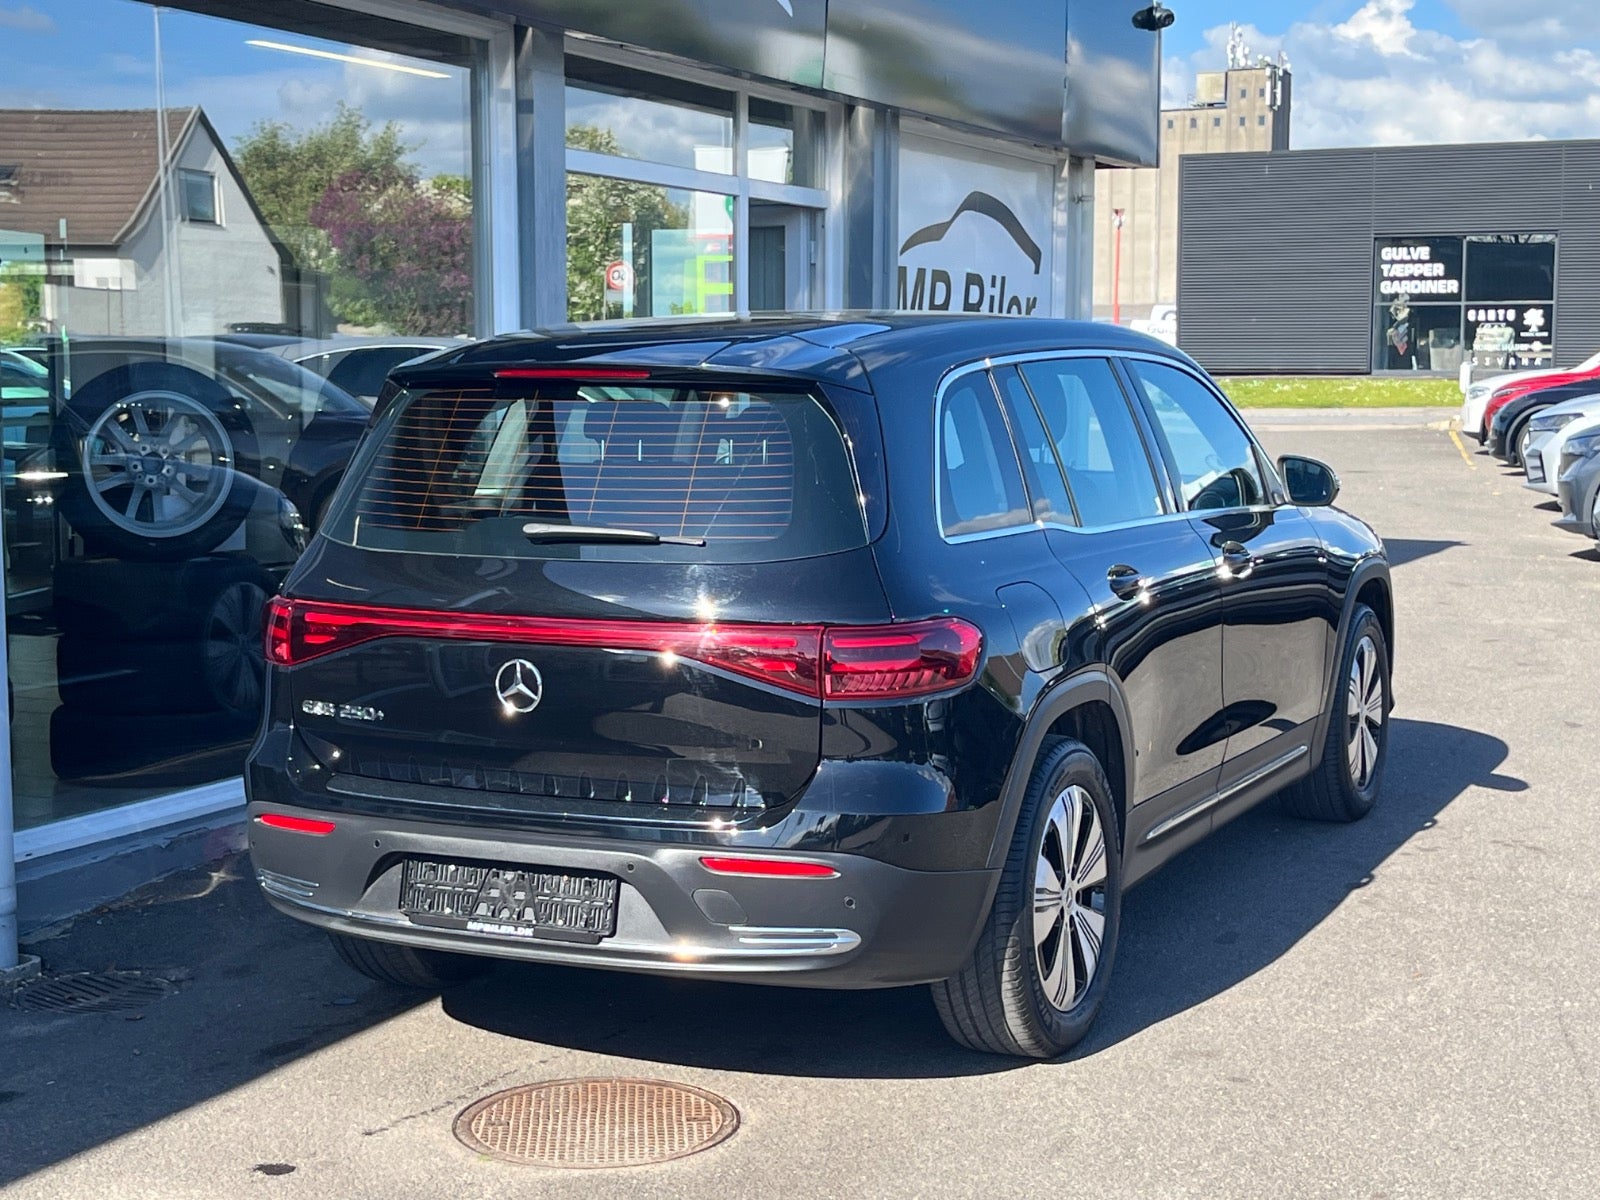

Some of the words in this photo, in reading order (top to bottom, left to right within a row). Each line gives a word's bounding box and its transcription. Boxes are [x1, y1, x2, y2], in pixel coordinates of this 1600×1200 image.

[1381, 246, 1430, 260] GULVE
[1381, 263, 1445, 277] TÆPPER
[1380, 279, 1459, 294] GARDINER
